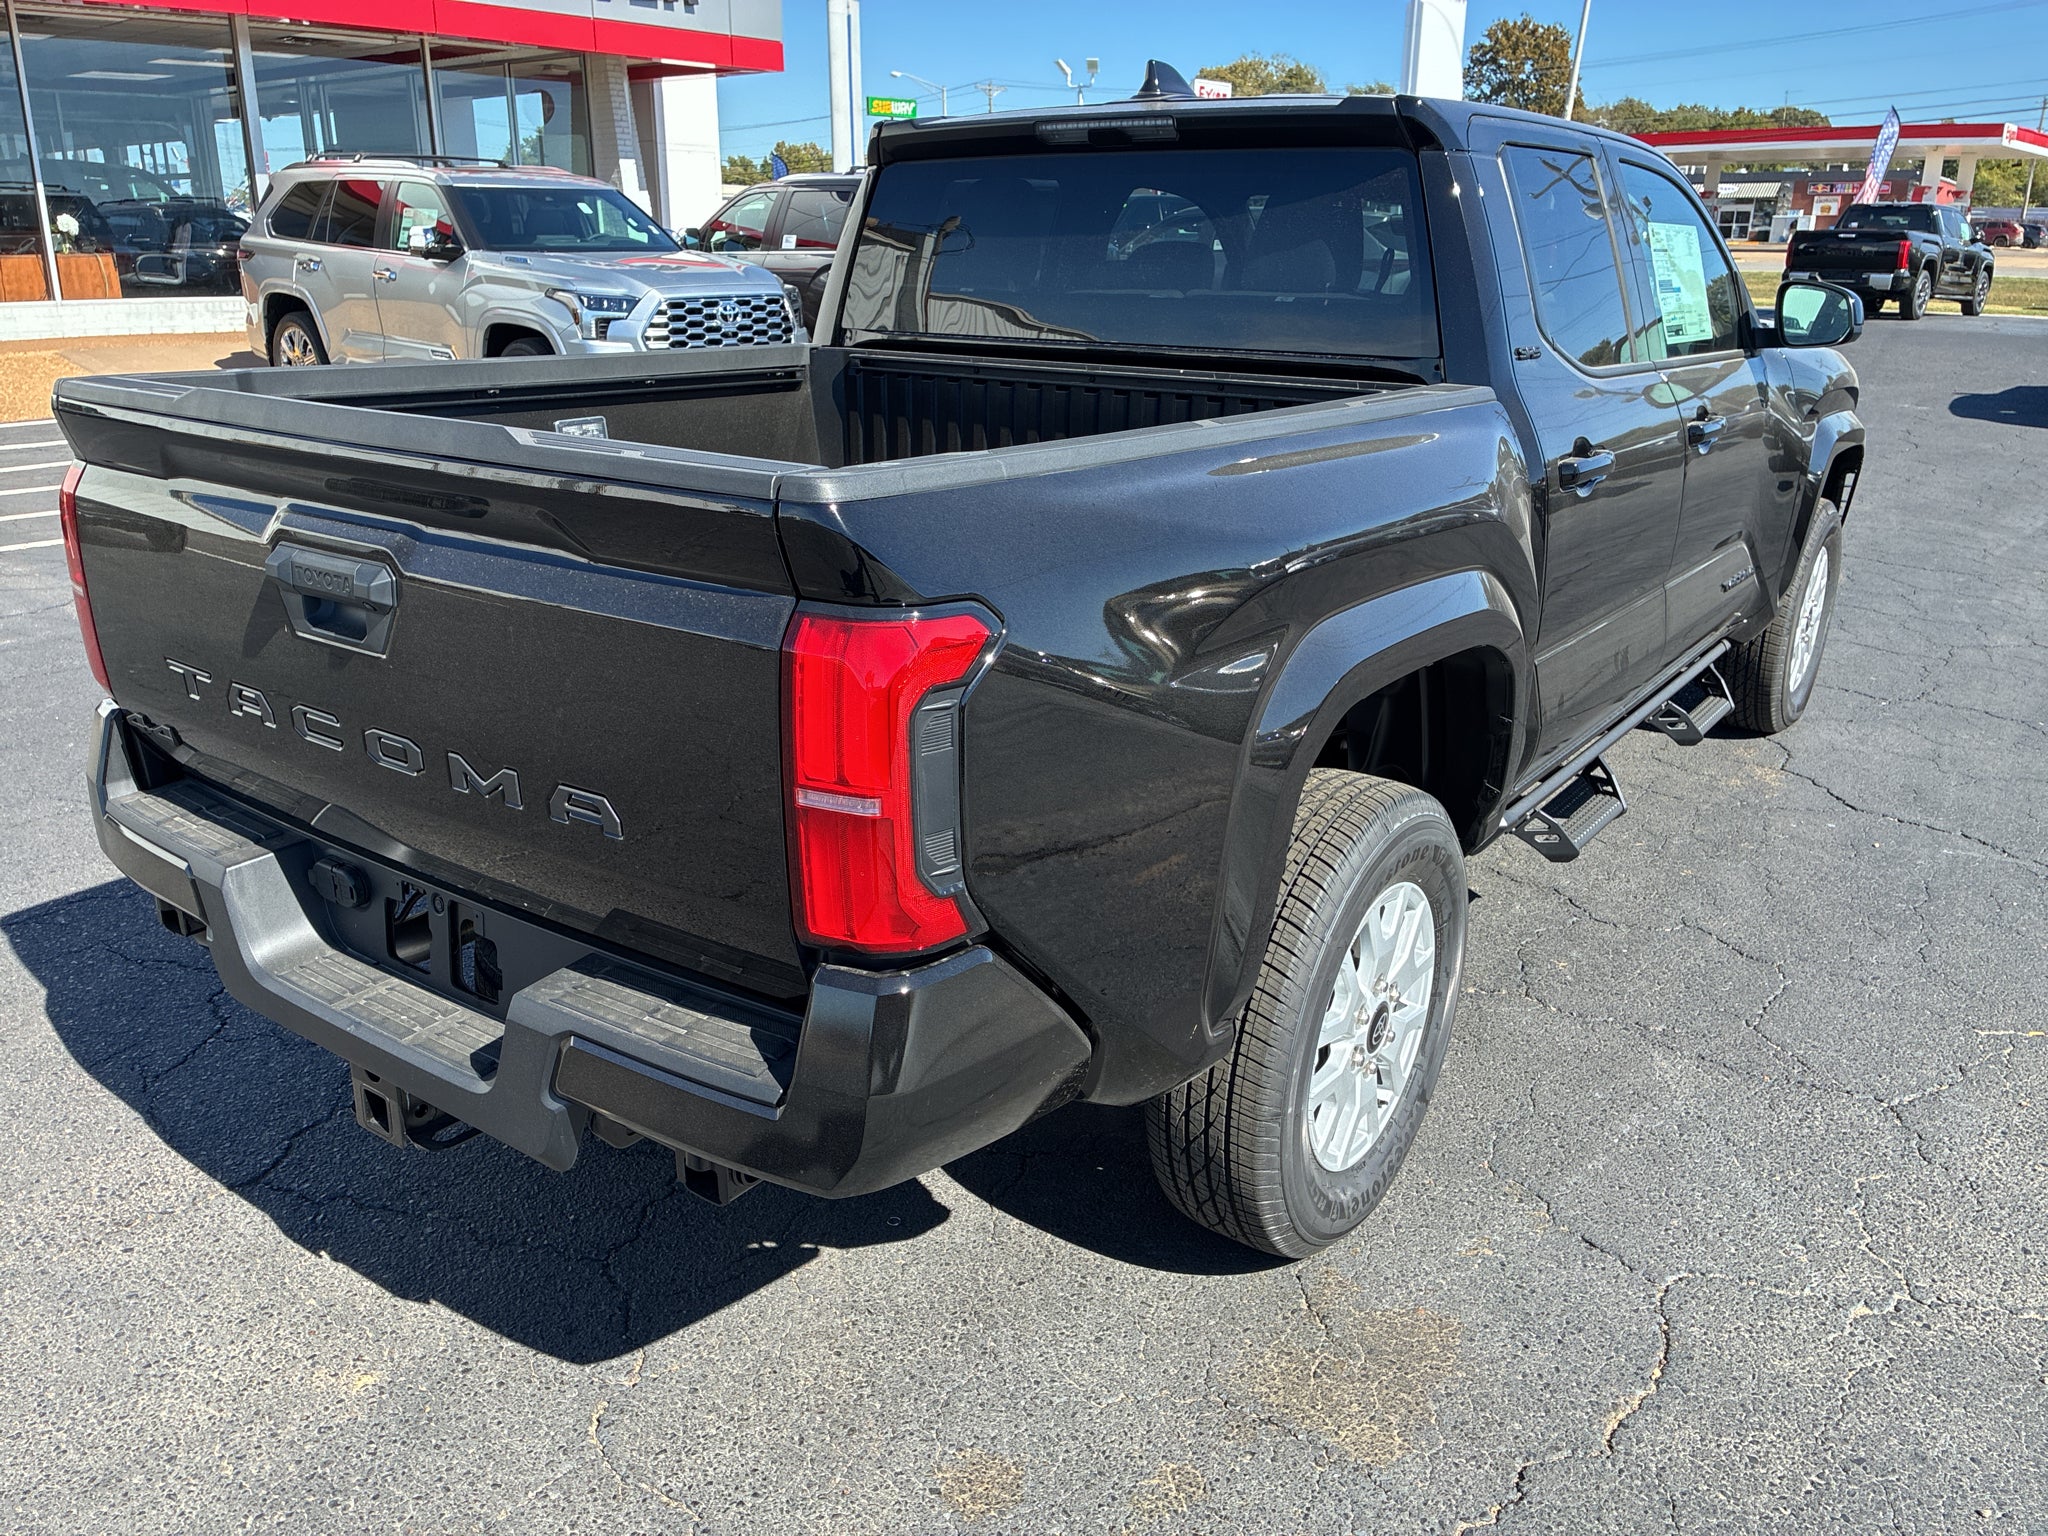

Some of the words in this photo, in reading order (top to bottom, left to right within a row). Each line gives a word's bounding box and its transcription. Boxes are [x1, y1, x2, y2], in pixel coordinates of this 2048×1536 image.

[871, 99, 916, 115] SUBWAY
[294, 564, 353, 594] TOYOTA
[164, 657, 625, 841] TACOMA
